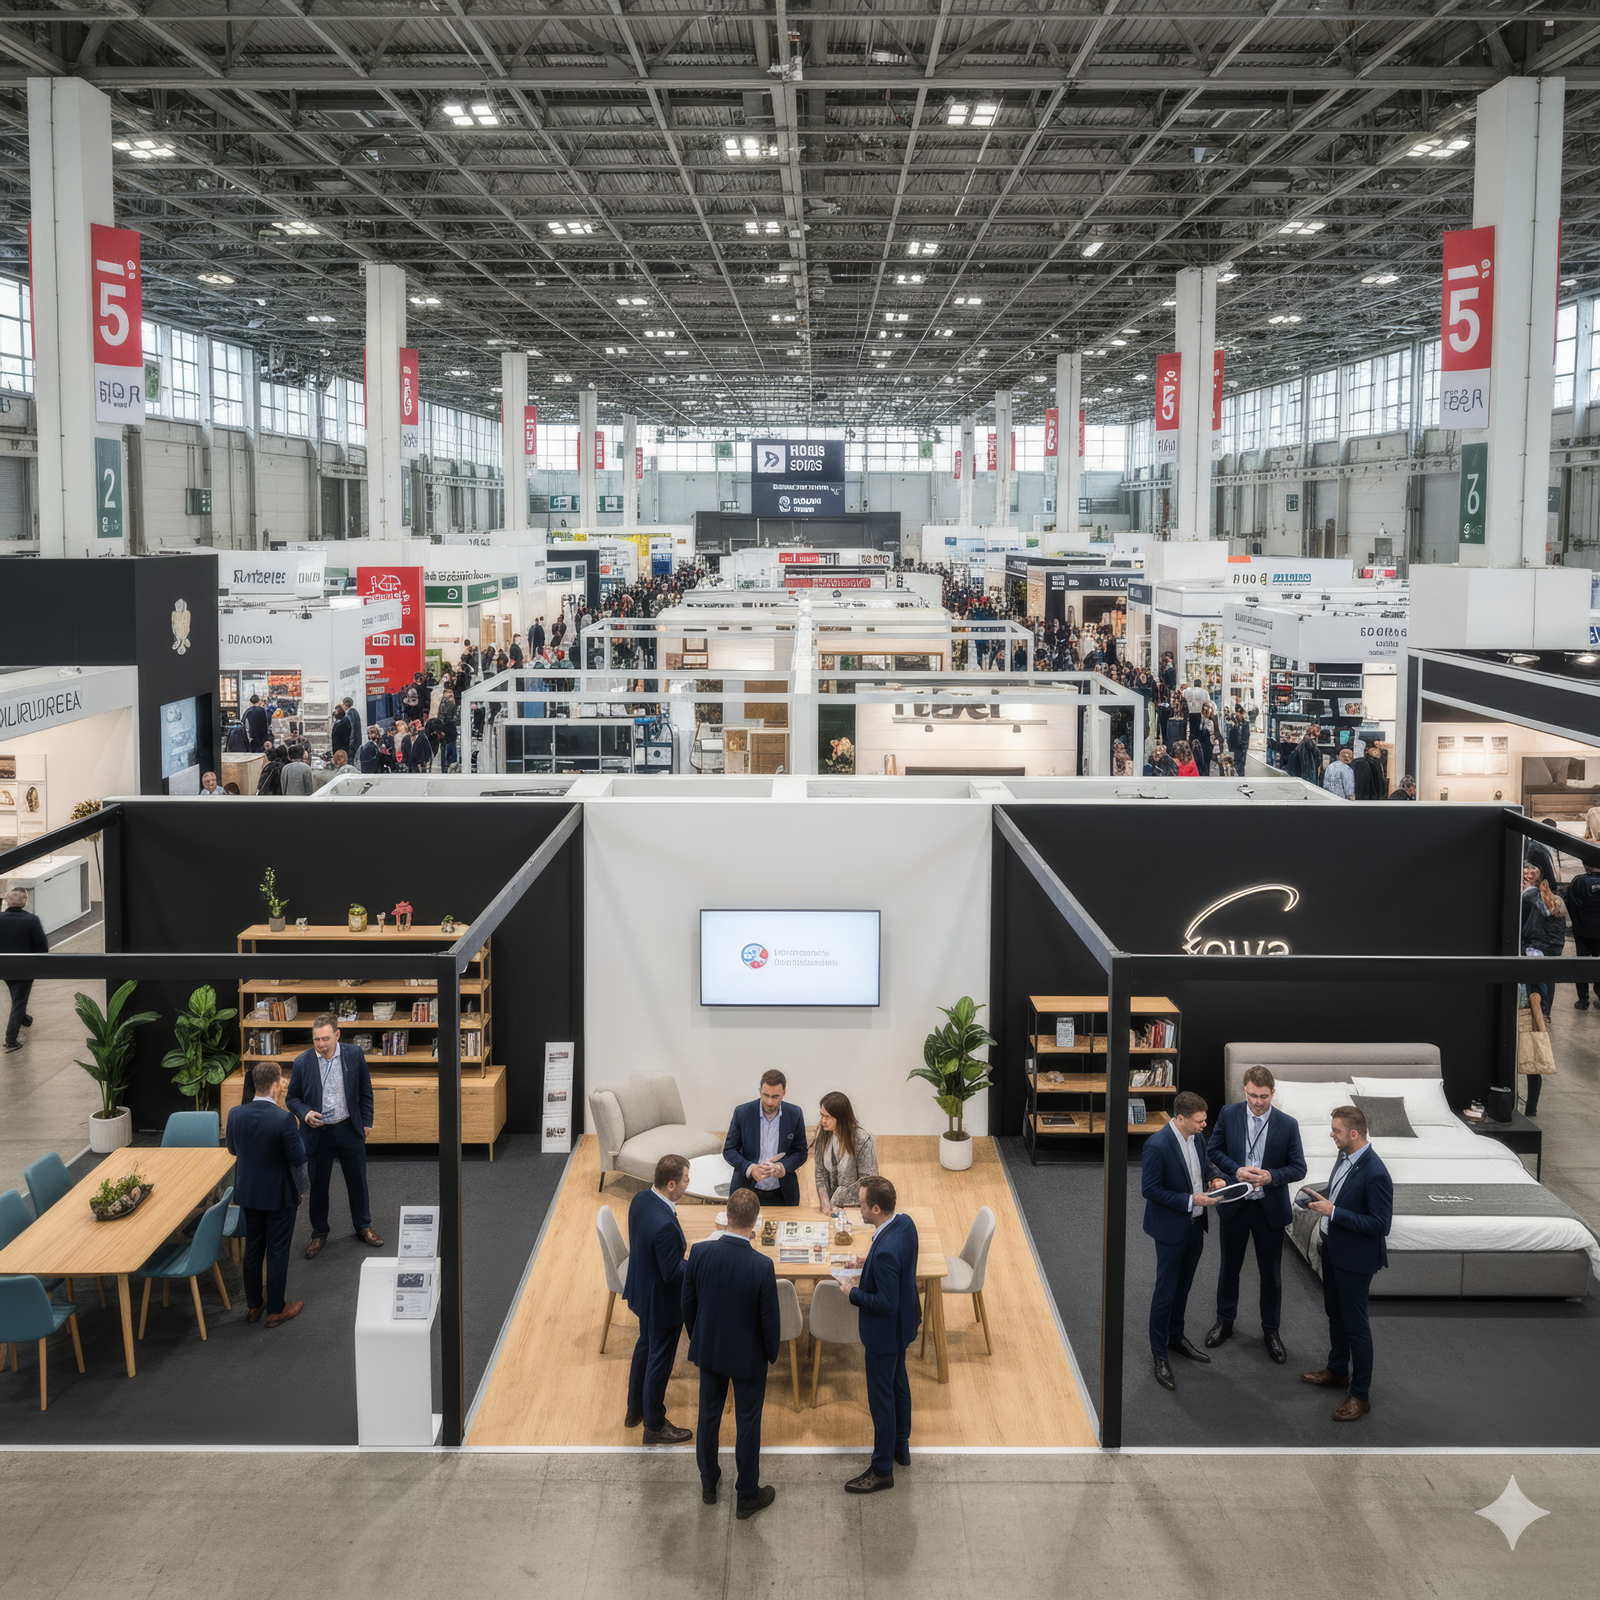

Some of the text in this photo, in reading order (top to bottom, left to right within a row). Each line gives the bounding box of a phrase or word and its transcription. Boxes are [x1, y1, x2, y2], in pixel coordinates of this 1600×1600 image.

[100, 282, 130, 346] 5
[1449, 287, 1481, 353] 5
[104, 468, 116, 509] 2
